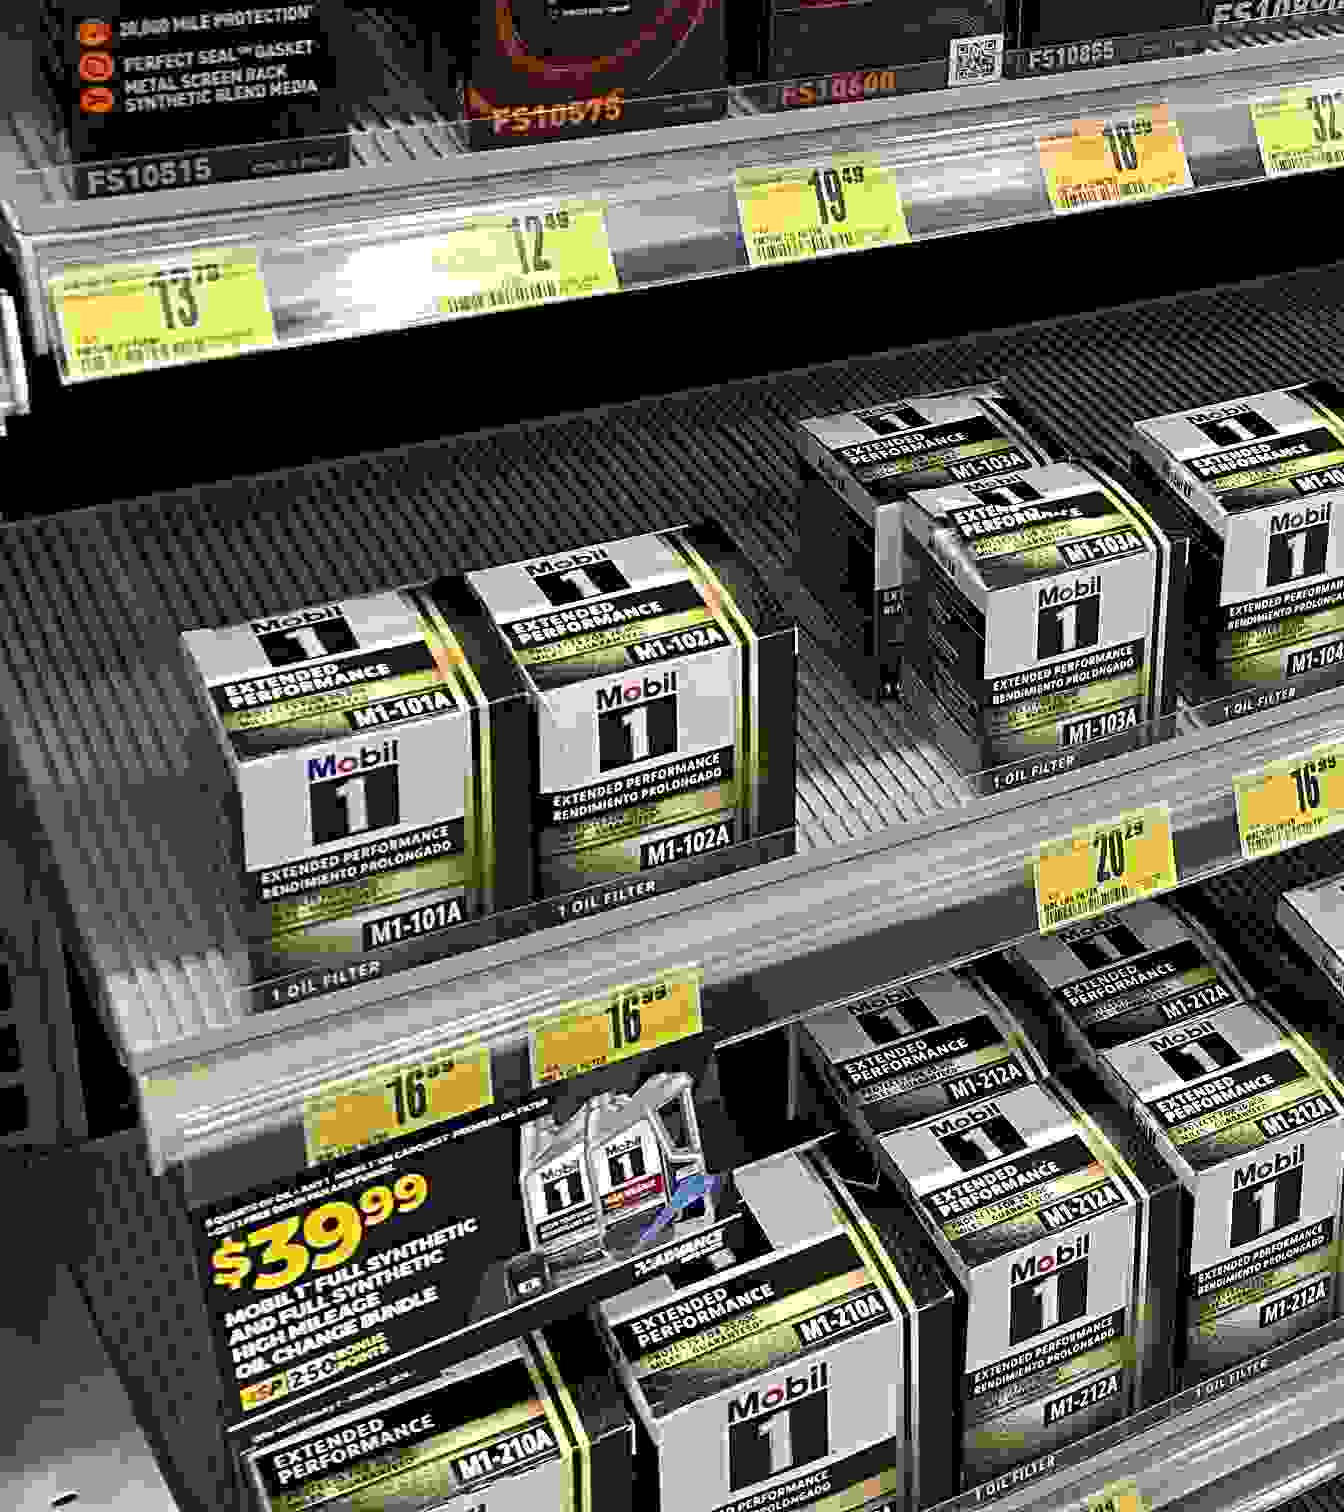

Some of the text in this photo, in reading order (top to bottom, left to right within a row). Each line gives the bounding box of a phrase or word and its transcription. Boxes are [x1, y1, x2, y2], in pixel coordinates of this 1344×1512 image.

[124, 39, 313, 73] PERFECT GASKET
[1028, 42, 1115, 68] FS10855
[125, 74, 172, 94] METAL
[178, 69, 241, 90] SCREEN
[125, 78, 318, 113] SYNTHETIC BLEND MEDIA
[86, 159, 212, 198] FS10515
[1269, 502, 1331, 534] Mobil
[524, 546, 609, 578] Mobil
[1038, 576, 1102, 608] Mobil
[517, 600, 664, 648] PERFORMANCE
[224, 661, 340, 699] EXTENDED
[595, 671, 679, 712] Mobil
[352, 688, 456, 729] M1-101A
[1067, 709, 1138, 746] M1-103A
[306, 739, 399, 781] Mobil
[260, 824, 452, 885] EXTENDED PERFORMANCE
[646, 823, 730, 868] M1-102A
[602, 880, 656, 908] FILTER
[370, 900, 463, 948] M1-101A
[948, 1061, 1024, 1102] M1-212A
[930, 1102, 1001, 1140] Mobil
[1262, 1097, 1333, 1137] M1-212A
[1042, 1185, 1128, 1230] M1-212A
[314, 1263, 364, 1294] FULL
[368, 1218, 479, 1274] SYNTHETIC
[1010, 1233, 1090, 1282] Mobil
[229, 1246, 446, 1348] AND FULL SYNTHETIC
[232, 1292, 383, 1363] HIGH MILEAGE
[236, 1285, 440, 1379] OIL CHANGE BUNDLE
[799, 1293, 886, 1344] M1-210A
[728, 1361, 829, 1421] Mobil
[1049, 1375, 1119, 1424] M1-212A
[273, 1416, 386, 1471] EXTENDED
[278, 1414, 436, 1484] PERFORMANCE
[458, 1429, 556, 1482] M1-210A
